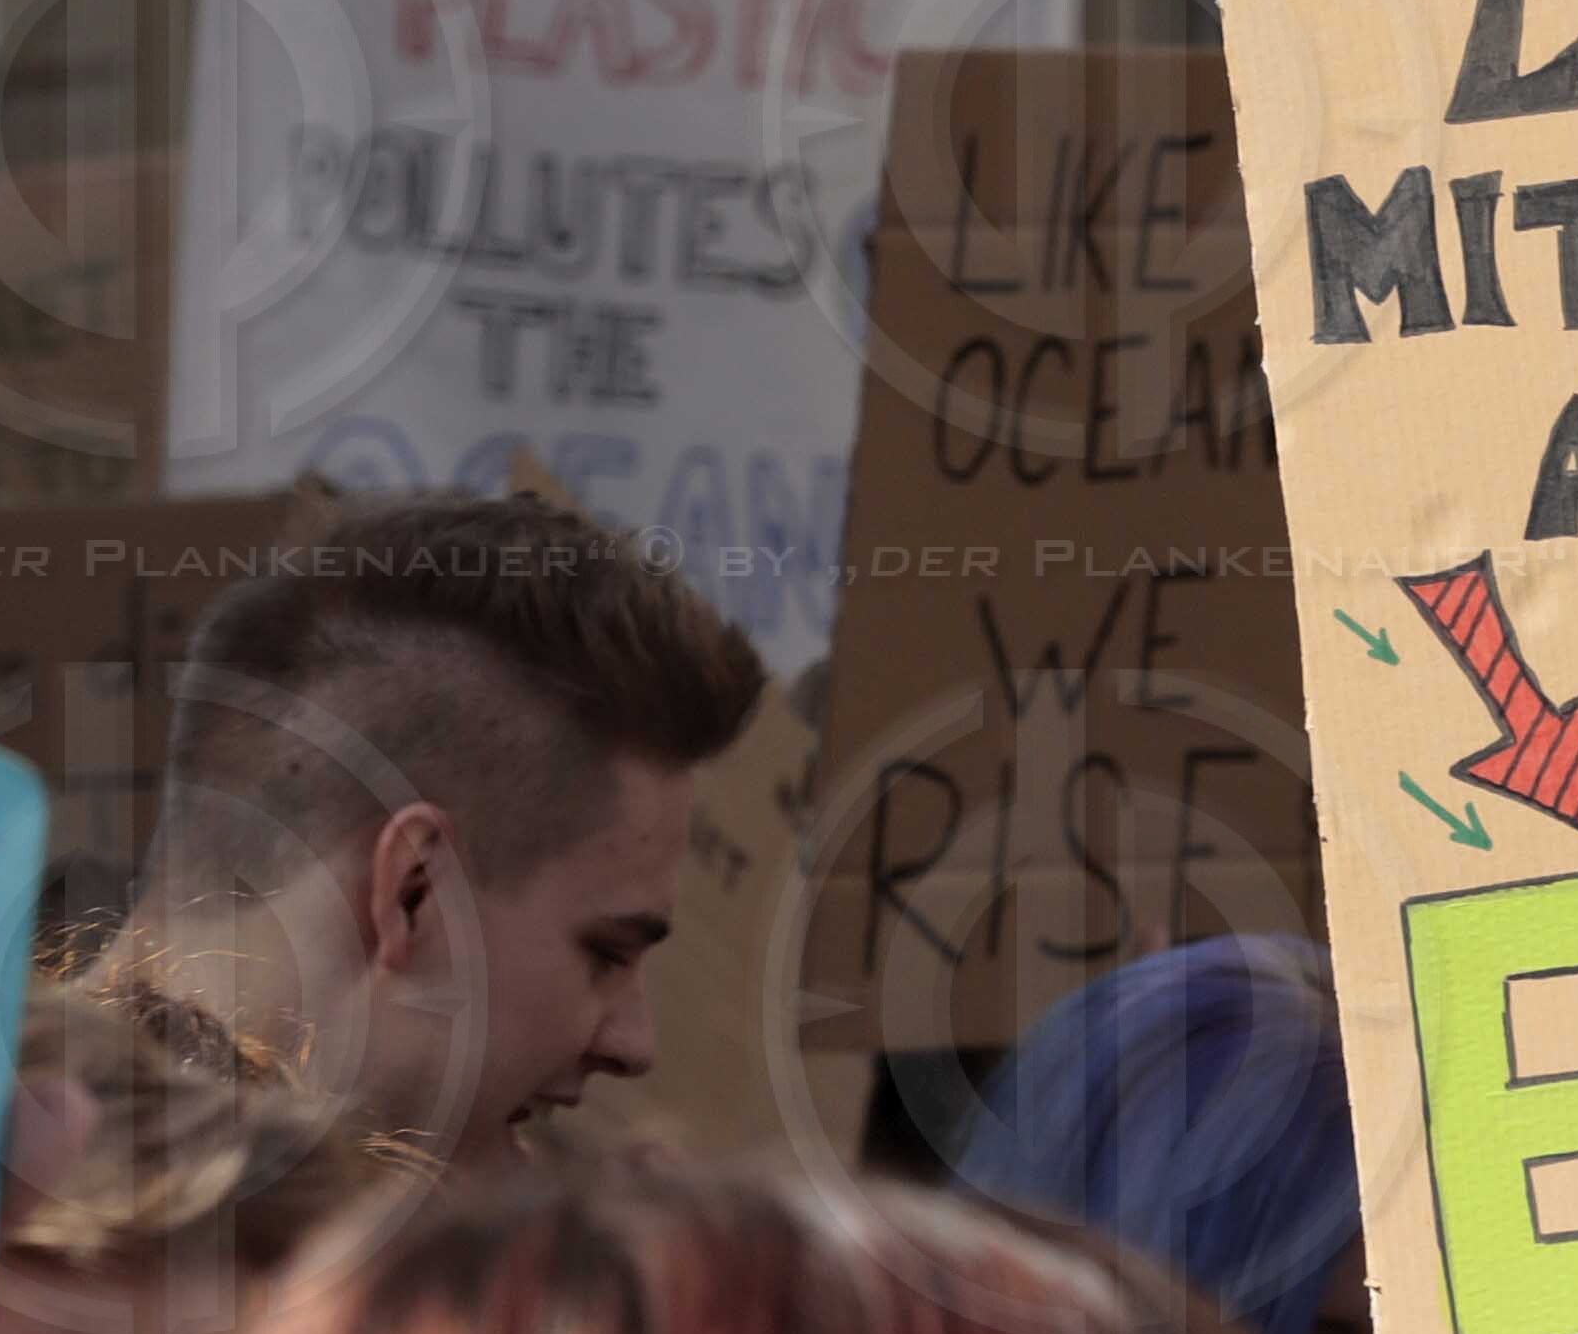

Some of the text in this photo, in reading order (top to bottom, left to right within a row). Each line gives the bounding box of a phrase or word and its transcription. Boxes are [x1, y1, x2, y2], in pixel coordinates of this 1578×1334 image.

[288, 123, 815, 295] POLLUTES
[952, 133, 1214, 295] LIKE
[452, 284, 660, 411] THE
[975, 567, 1216, 721] WE
[862, 750, 1259, 975] RISE
